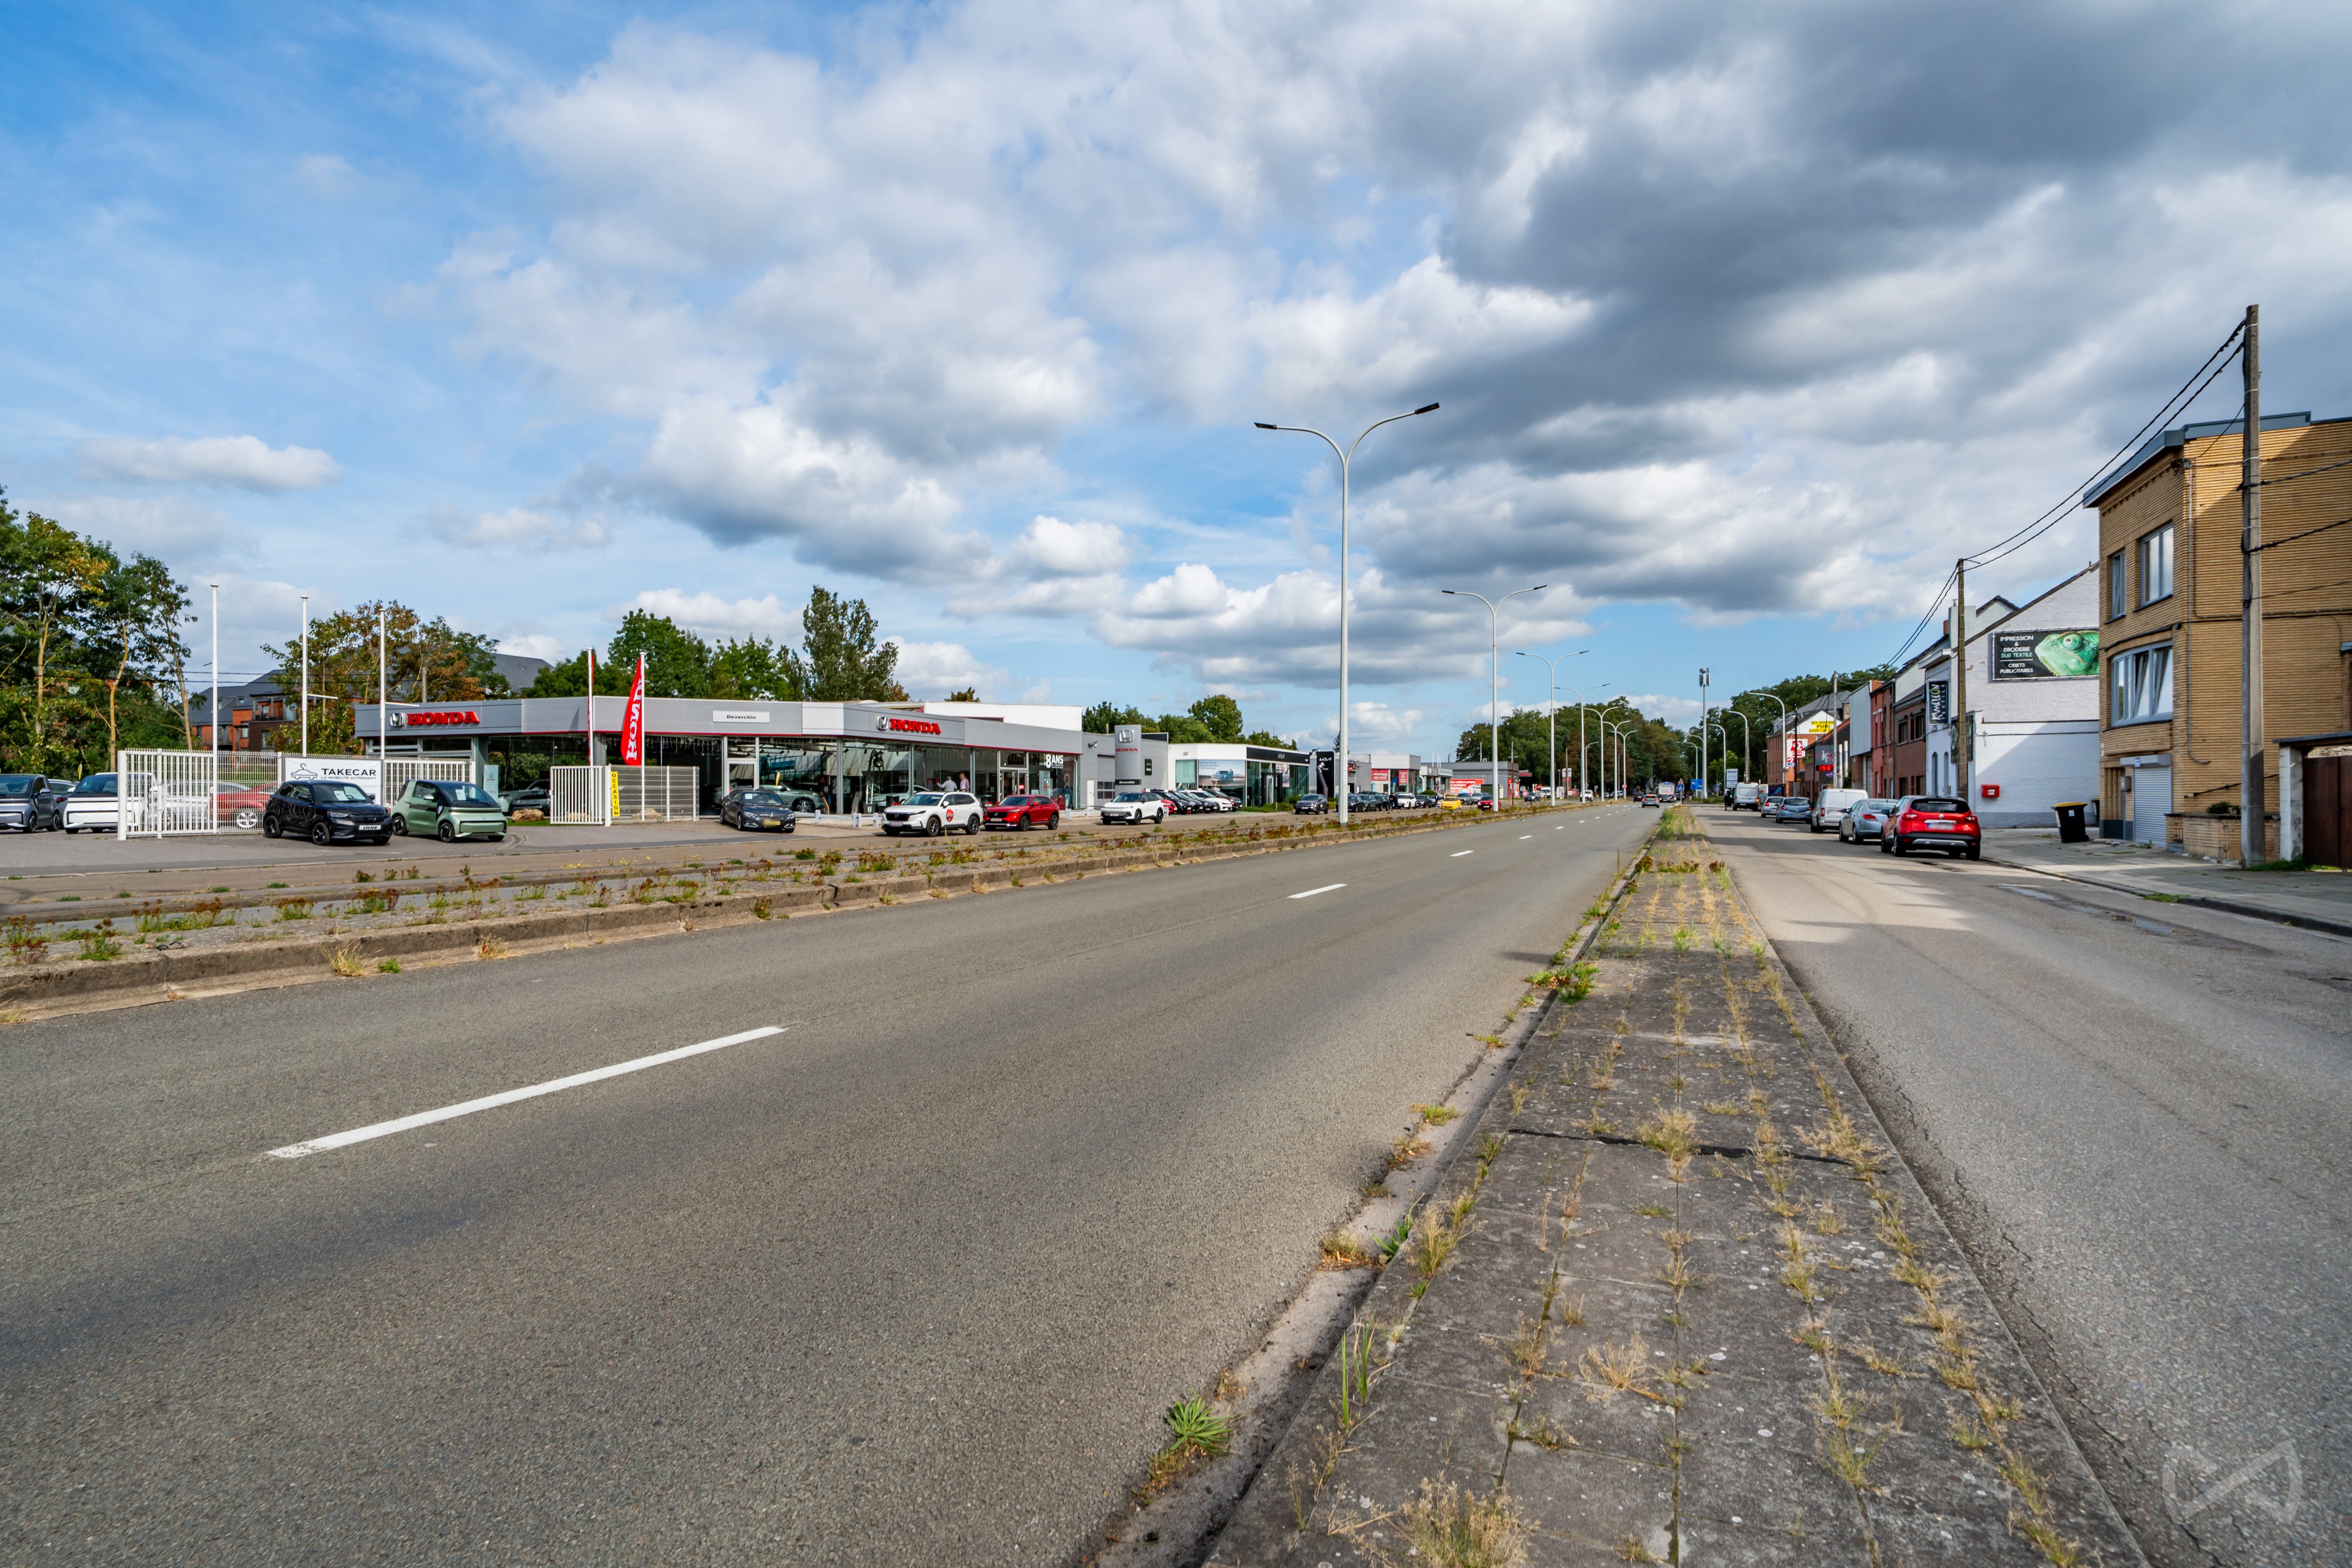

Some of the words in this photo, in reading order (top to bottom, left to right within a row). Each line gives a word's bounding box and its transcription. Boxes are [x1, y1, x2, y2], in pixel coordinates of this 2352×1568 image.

[407, 711, 480, 725] HONDA
[626, 665, 642, 760] HOND
[890, 719, 942, 734] HONDA
[1046, 754, 1052, 768] 8
[1052, 754, 1063, 764] ANS
